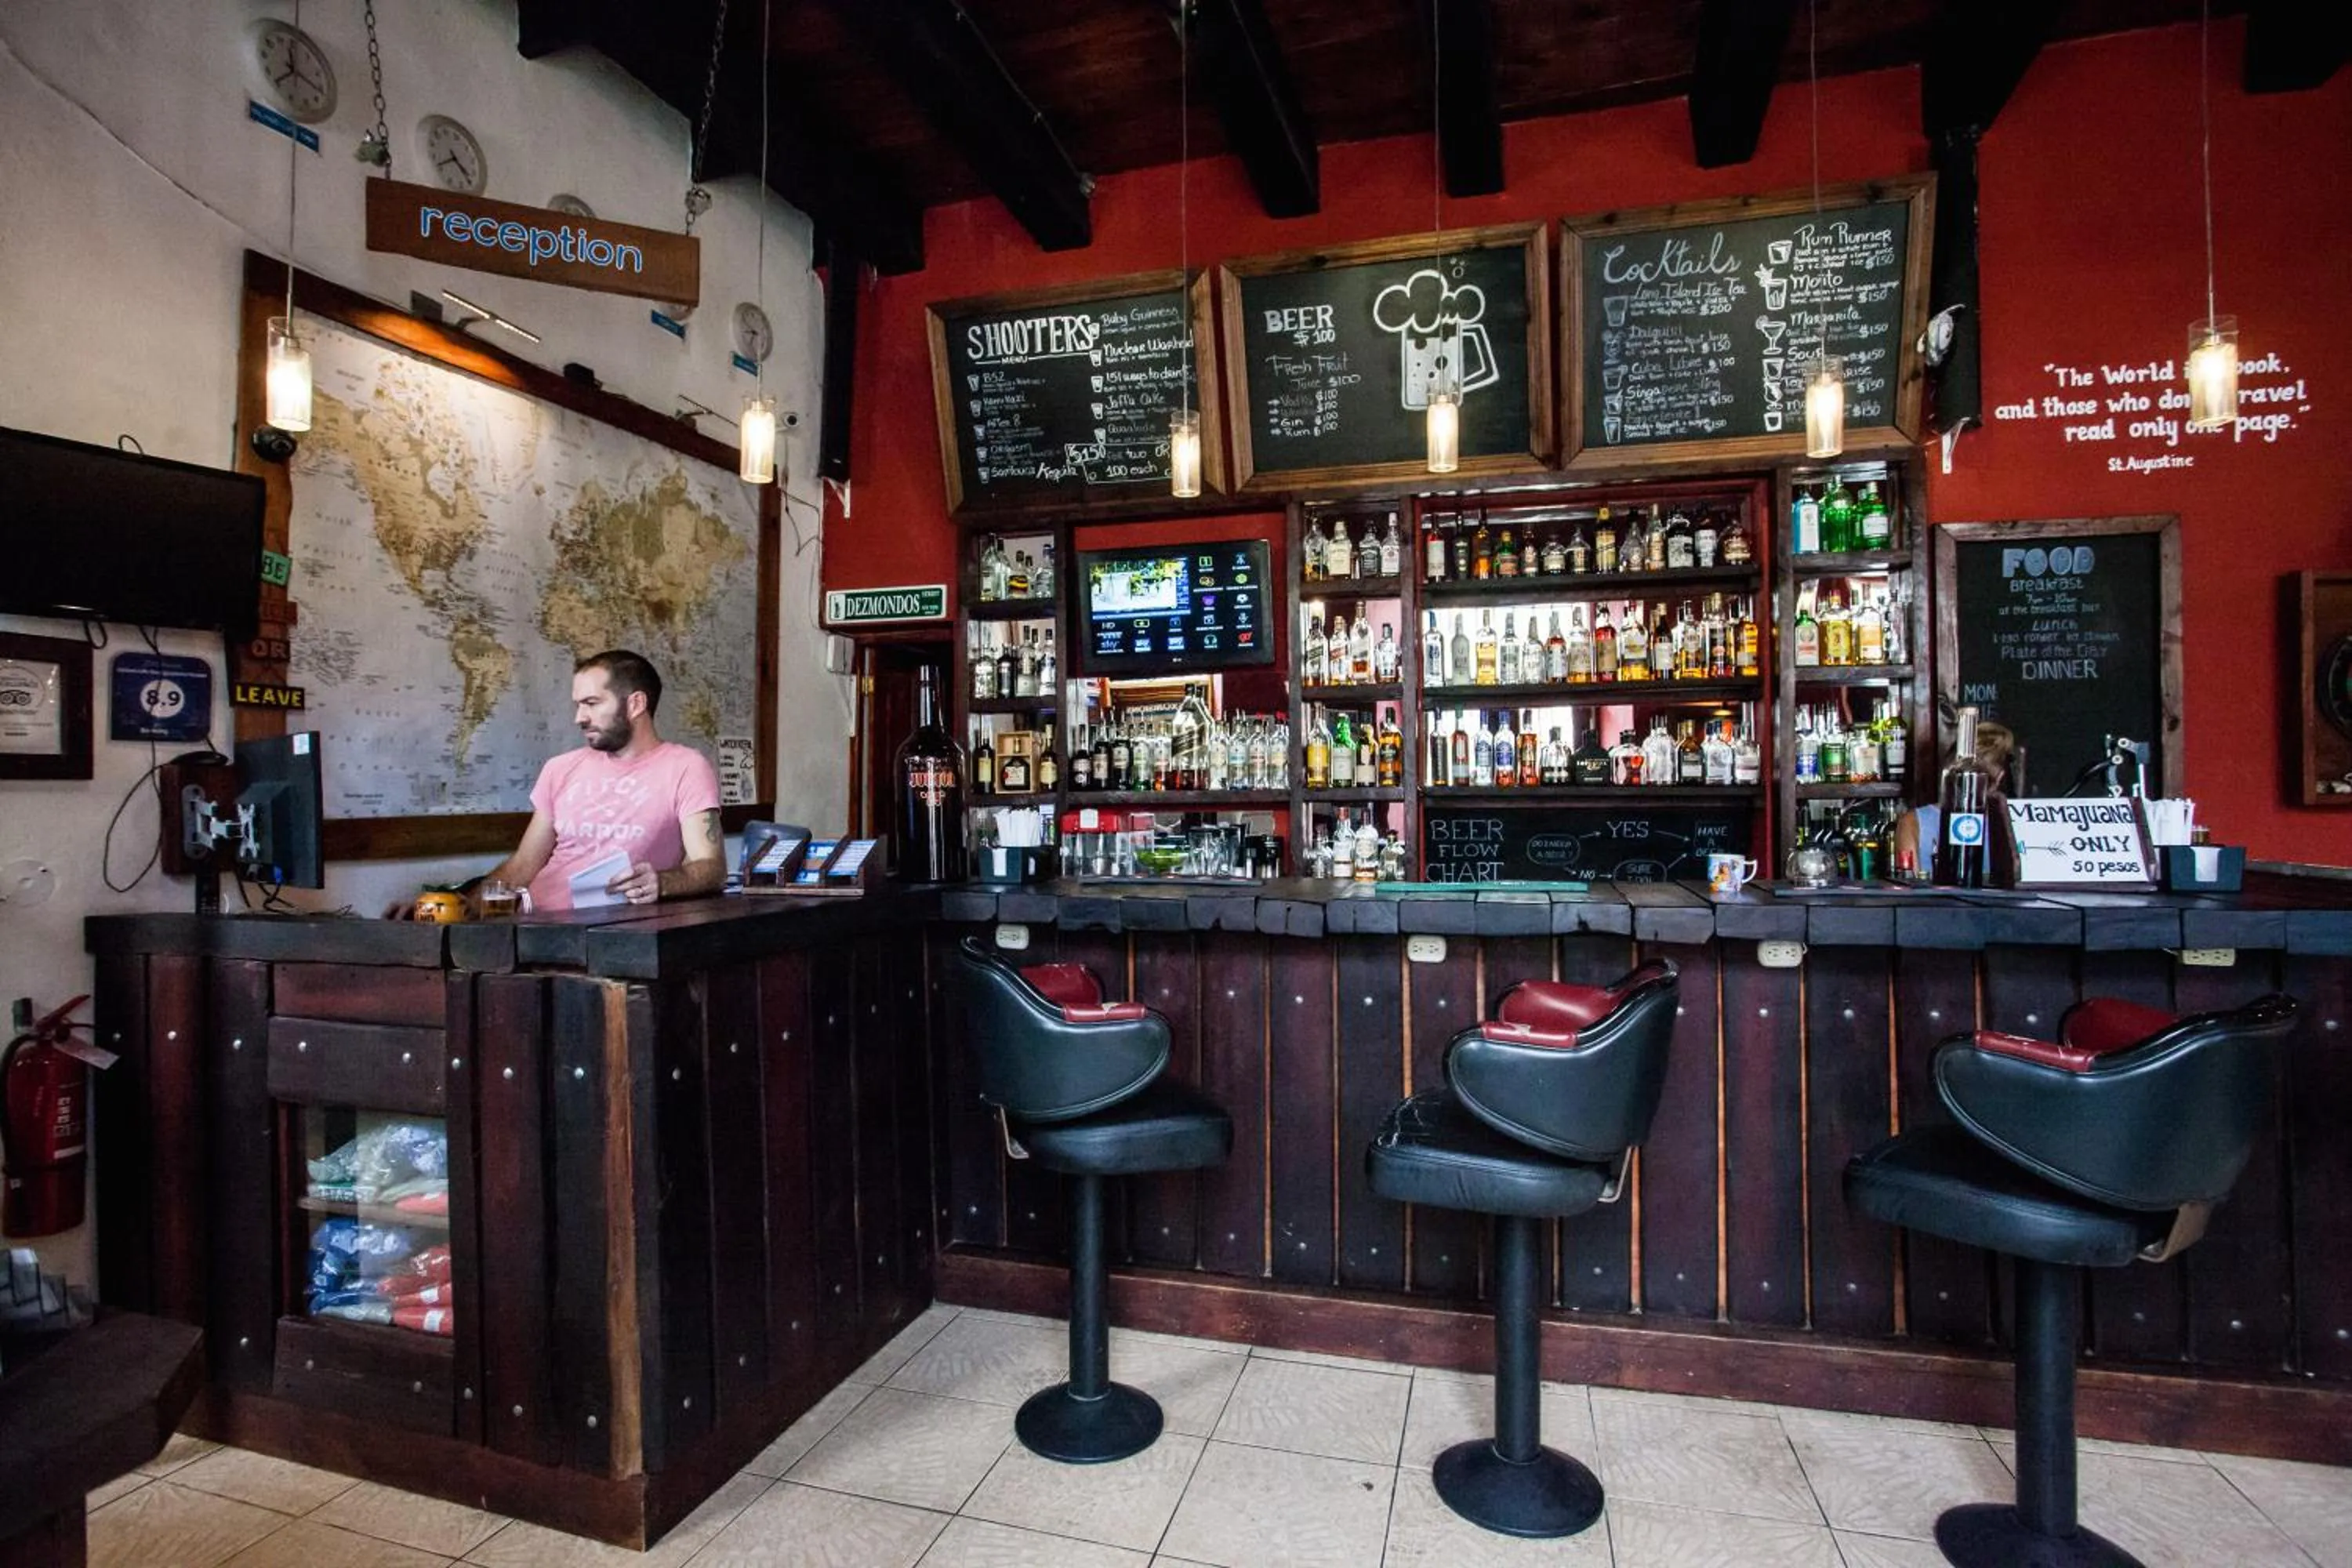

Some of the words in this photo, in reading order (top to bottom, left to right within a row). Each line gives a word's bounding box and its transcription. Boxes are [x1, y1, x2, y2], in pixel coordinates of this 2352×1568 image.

[419, 205, 643, 273] reception
[1864, 254, 1895, 270] $150
[1789, 270, 1843, 290] Mojito
[1857, 289, 1889, 304] $150
[1263, 304, 1335, 333] BEER
[1699, 303, 1733, 316] $200
[967, 314, 1095, 360] SHOOTERS
[1859, 323, 1889, 339] $150
[1700, 339, 1732, 354] $150
[983, 372, 1004, 383] B52
[1328, 374, 1362, 387] $100
[2100, 360, 2176, 386] World
[1994, 398, 2038, 420] and
[2042, 396, 2098, 418] those
[2106, 391, 2152, 413] who
[2238, 379, 2308, 405] ravel
[1280, 418, 1305, 427] Gin
[2063, 418, 2117, 443] read
[2129, 416, 2180, 447] only
[1105, 465, 1128, 478] 100
[1129, 460, 1159, 475] each
[2002, 546, 2096, 578] FOOD
[846, 593, 921, 617] DEZMONDOS
[2021, 659, 2100, 681] DINNER
[147, 689, 180, 706] 8.9
[235, 684, 303, 707] LEAVE
[1430, 819, 1504, 842] BEER
[1607, 821, 1649, 839] YES
[1438, 843, 1500, 858] FLOW
[2070, 835, 2131, 853] ONLY
[1425, 862, 1504, 884] CHART
[1579, 869, 1596, 880] NO
[2072, 860, 2095, 873] 50
[2098, 860, 2141, 877] pesos
